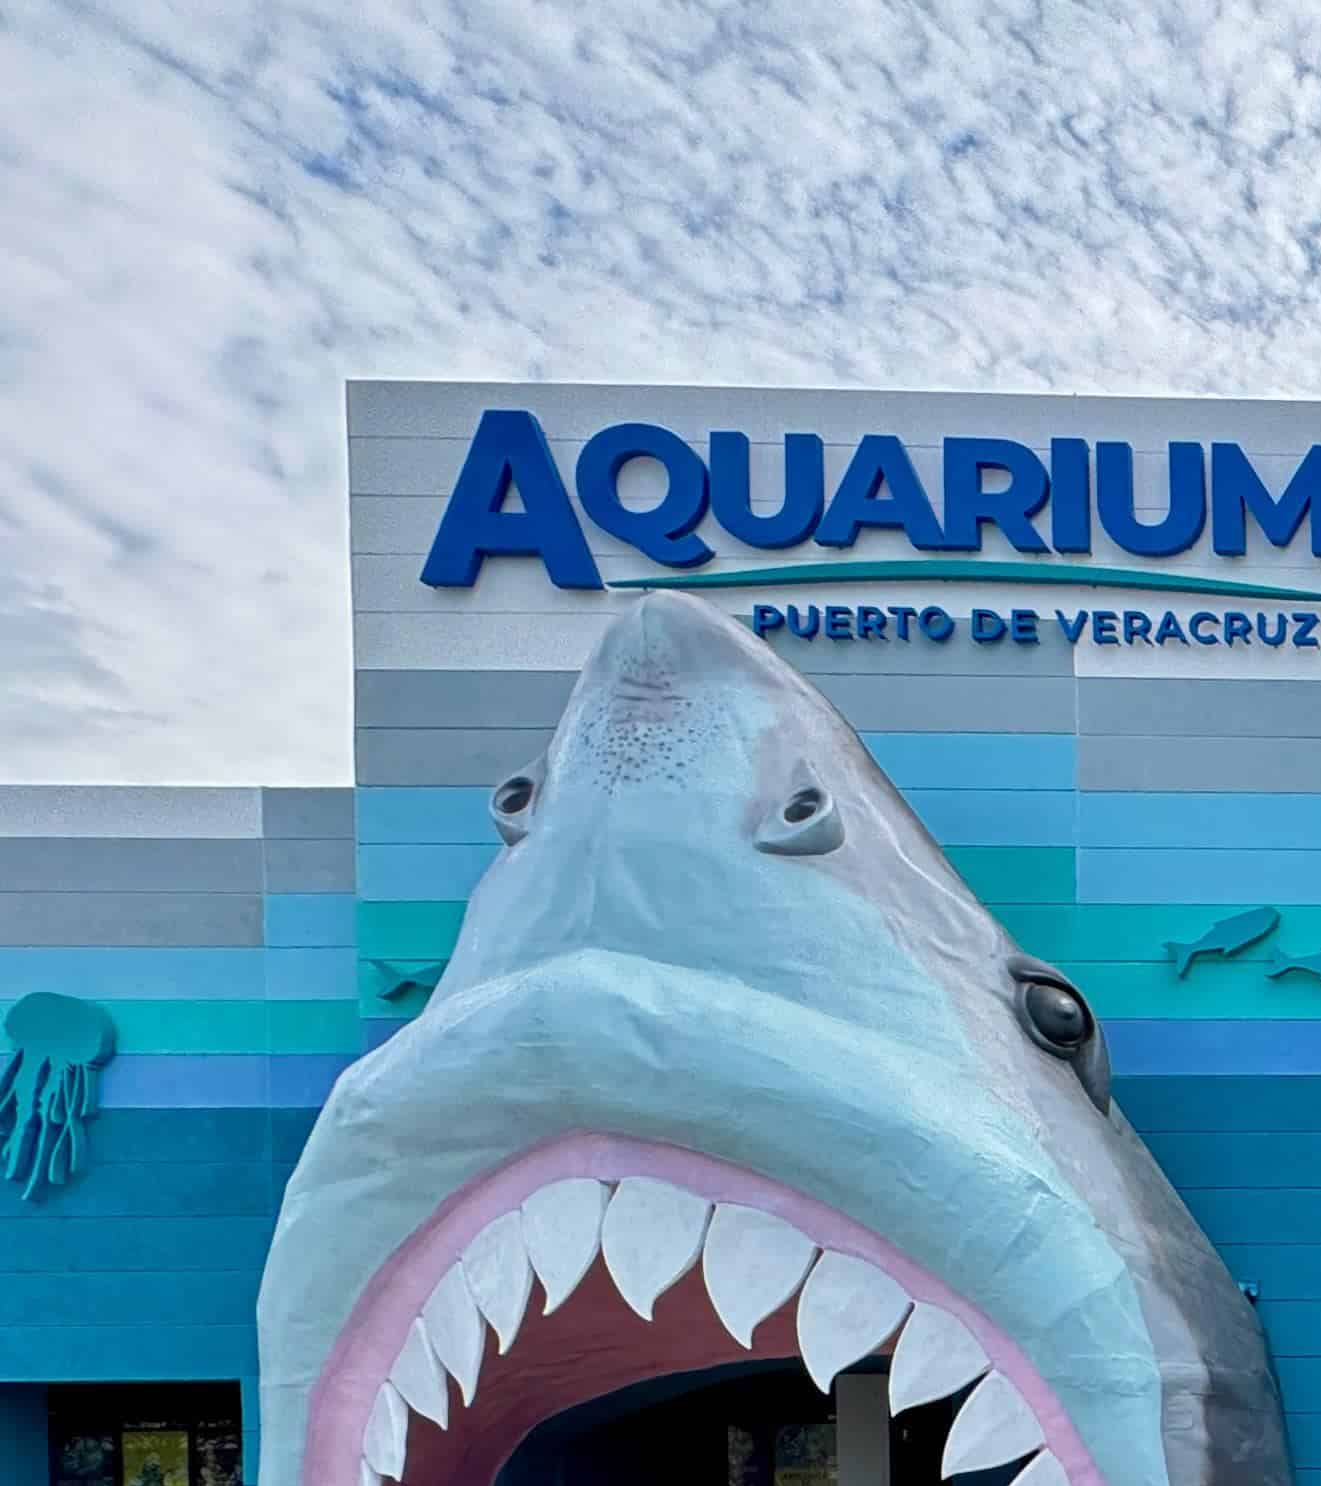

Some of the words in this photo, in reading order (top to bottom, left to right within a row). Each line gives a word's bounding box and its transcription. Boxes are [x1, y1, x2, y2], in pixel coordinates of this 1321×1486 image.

[752, 603, 955, 643] PUERTO
[971, 607, 1040, 644] DE
[1055, 608, 1321, 650] VERACRUZ
